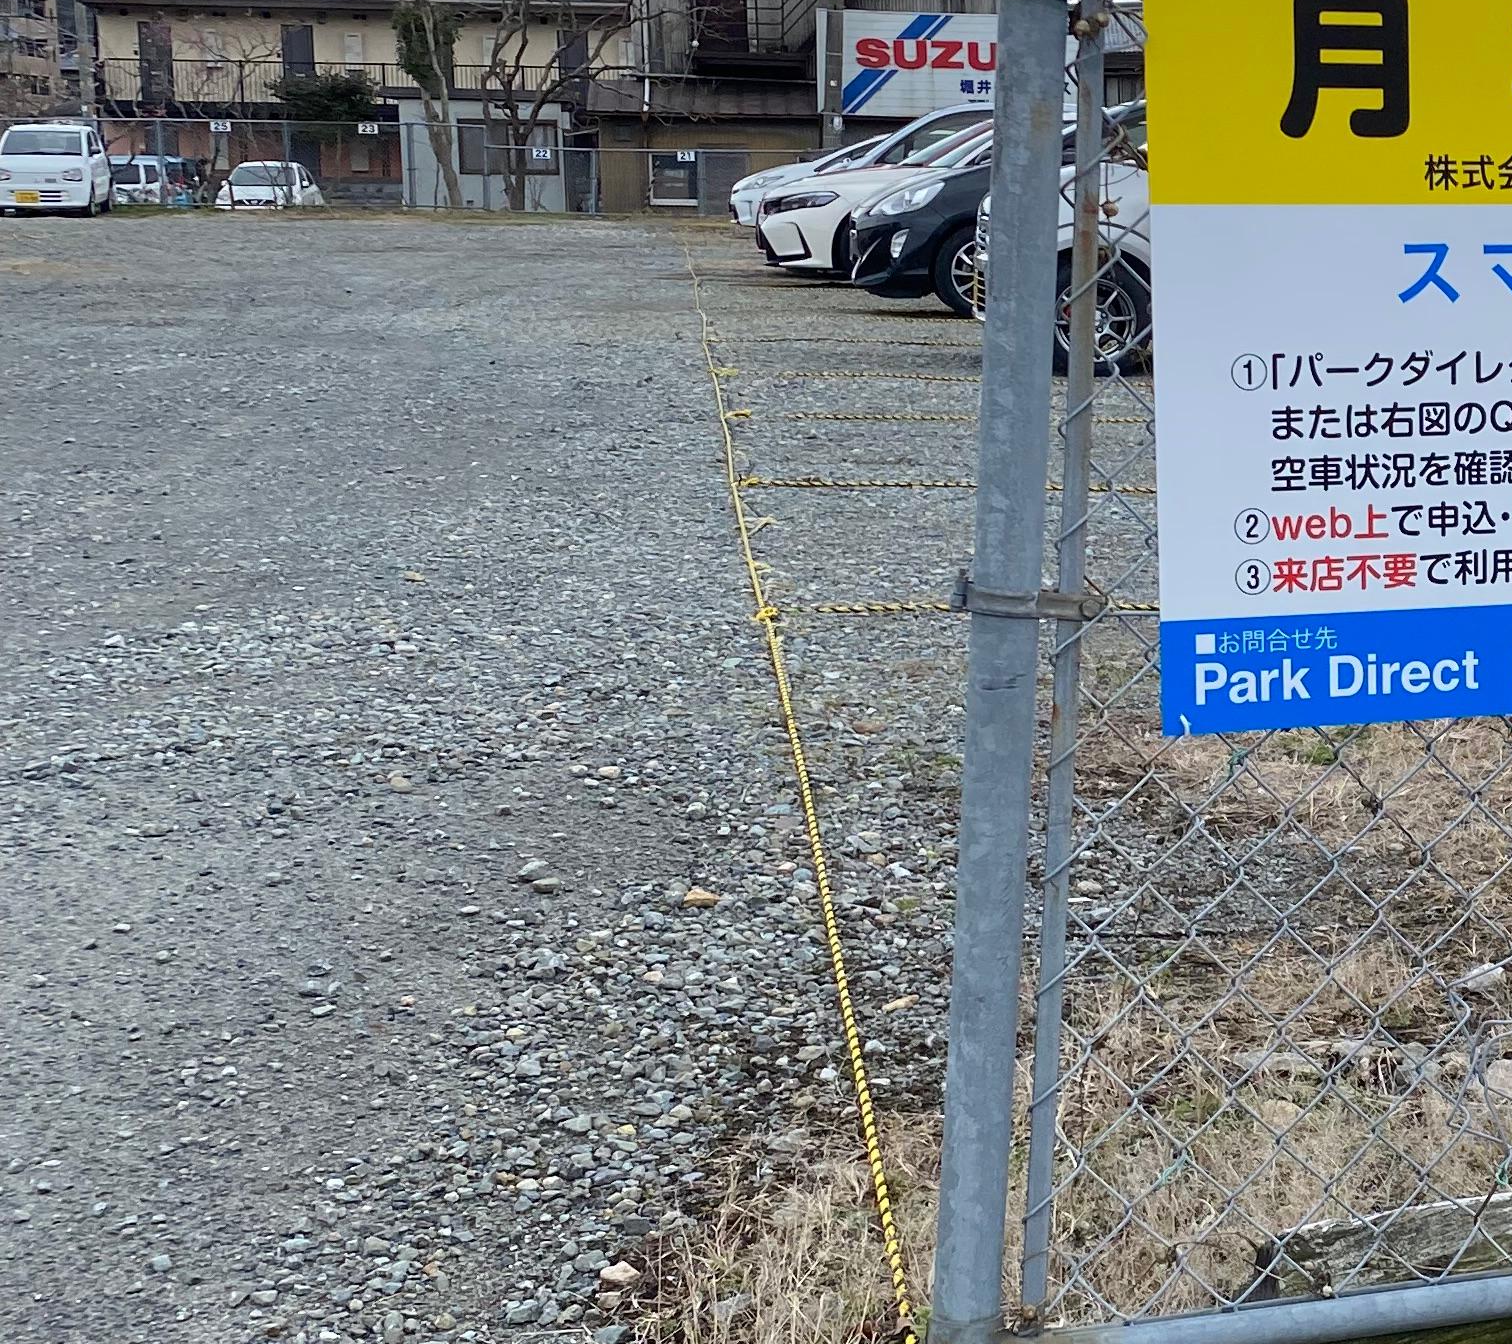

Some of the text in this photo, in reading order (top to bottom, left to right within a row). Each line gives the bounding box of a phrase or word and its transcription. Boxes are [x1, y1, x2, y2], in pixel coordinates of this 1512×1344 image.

[855, 38, 996, 71] SUZU
[213, 123, 228, 131] 25
[535, 149, 548, 158] 22
[680, 152, 691, 160] 21
[1195, 649, 1480, 706] Park Direct
